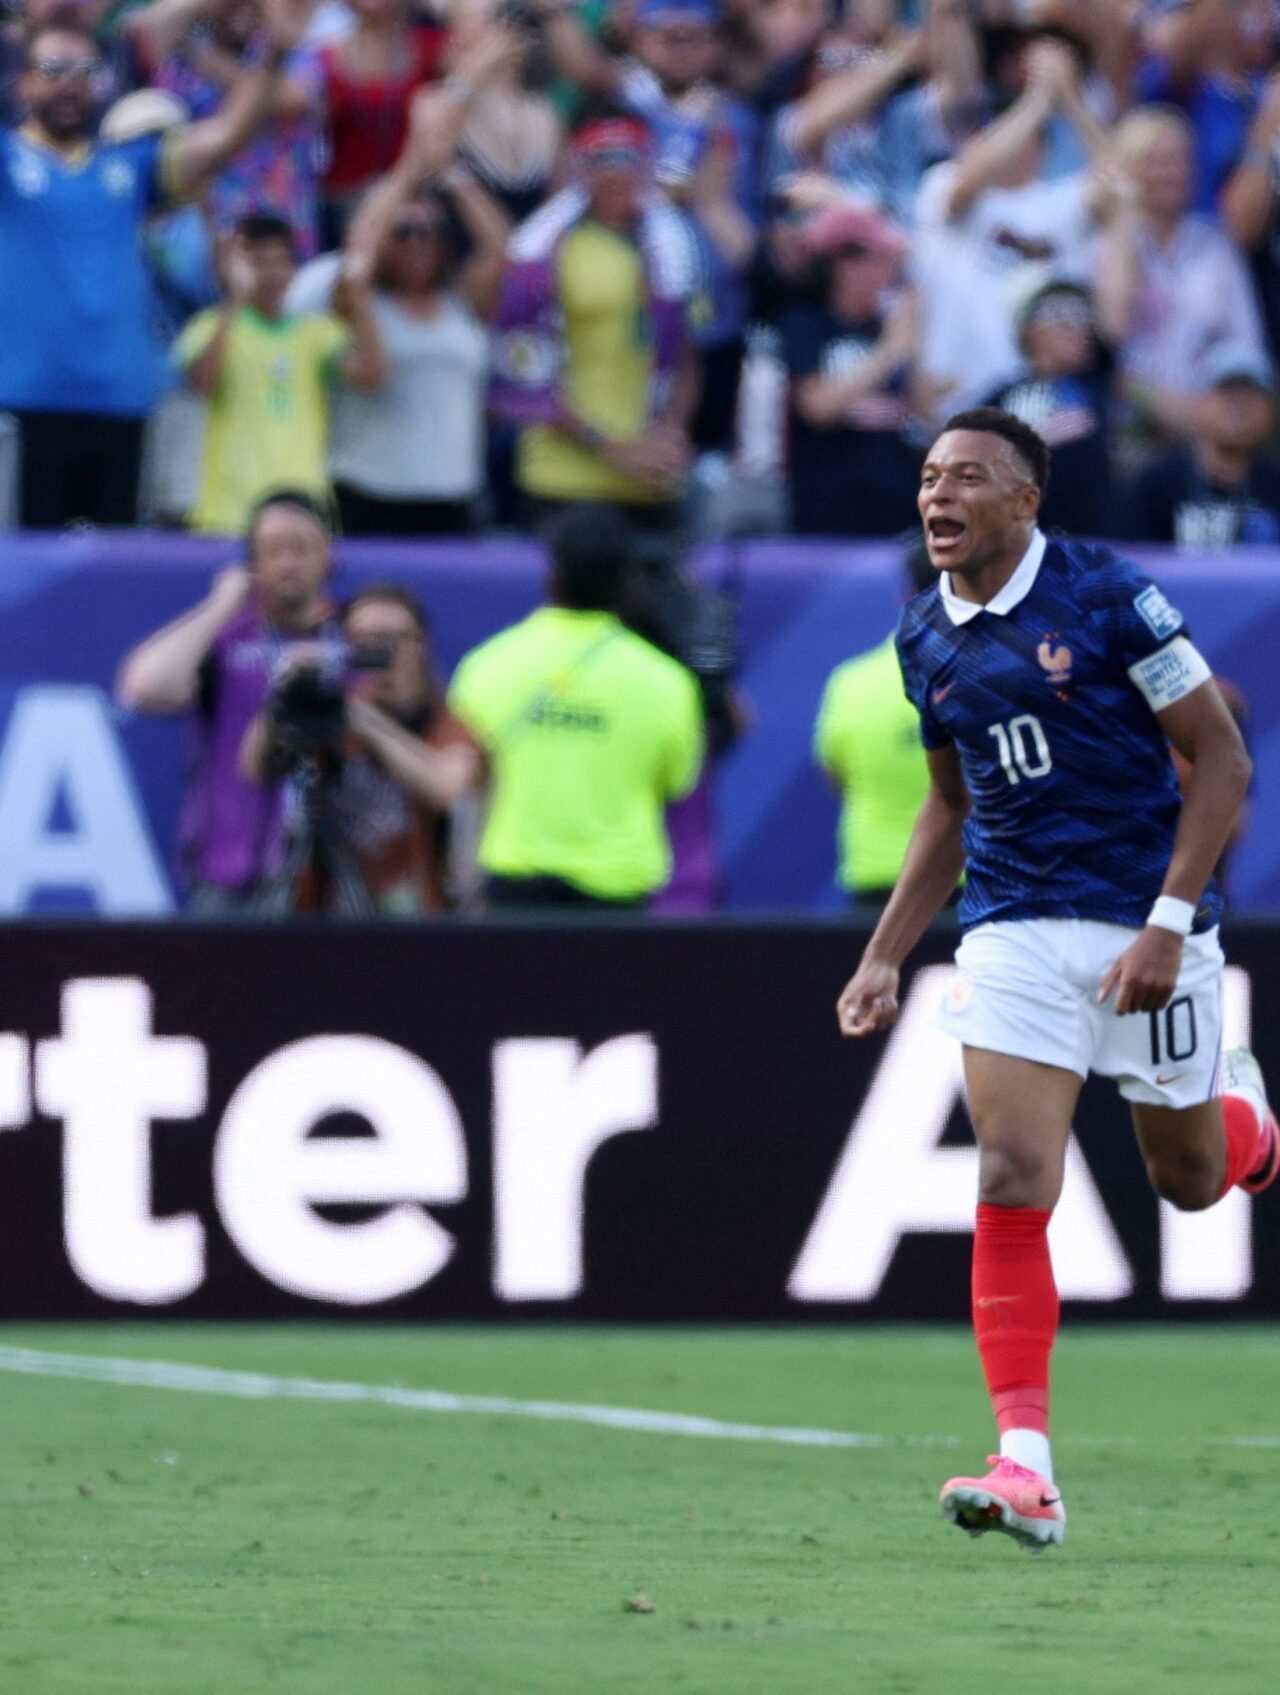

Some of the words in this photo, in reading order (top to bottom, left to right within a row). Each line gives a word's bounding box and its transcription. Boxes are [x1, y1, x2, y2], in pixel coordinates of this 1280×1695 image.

[0, 684, 178, 917] A
[987, 713, 1053, 785] 10
[1148, 994, 1198, 1066] 10
[0, 974, 659, 1304] ter
